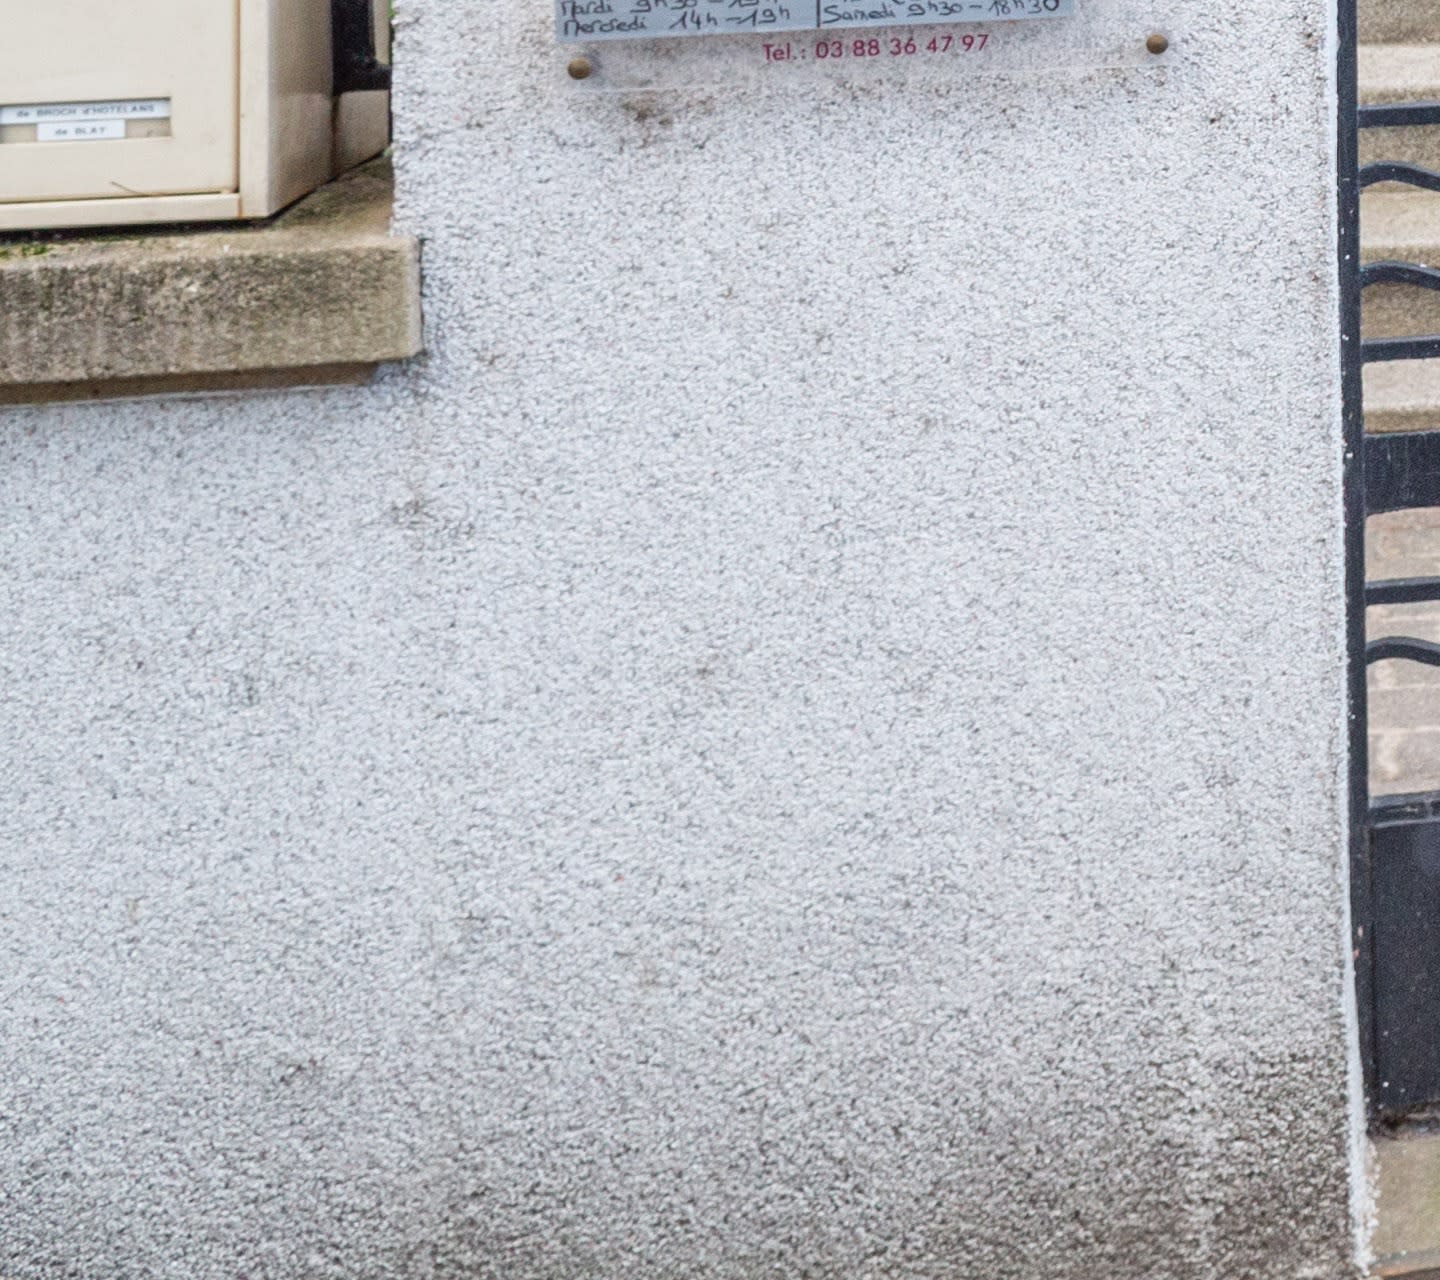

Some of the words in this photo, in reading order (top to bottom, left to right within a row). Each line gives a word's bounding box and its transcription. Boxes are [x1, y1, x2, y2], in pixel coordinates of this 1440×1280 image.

[561, 0, 613, 17] Mardi
[822, 3, 896, 24] Samedi
[907, 0, 963, 17] 9h30
[669, 11, 718, 30] 14h
[815, 41, 843, 59] 03
[853, 40, 880, 57] 88
[890, 37, 917, 55] 36
[926, 36, 953, 53] 47
[962, 34, 989, 51] 97
